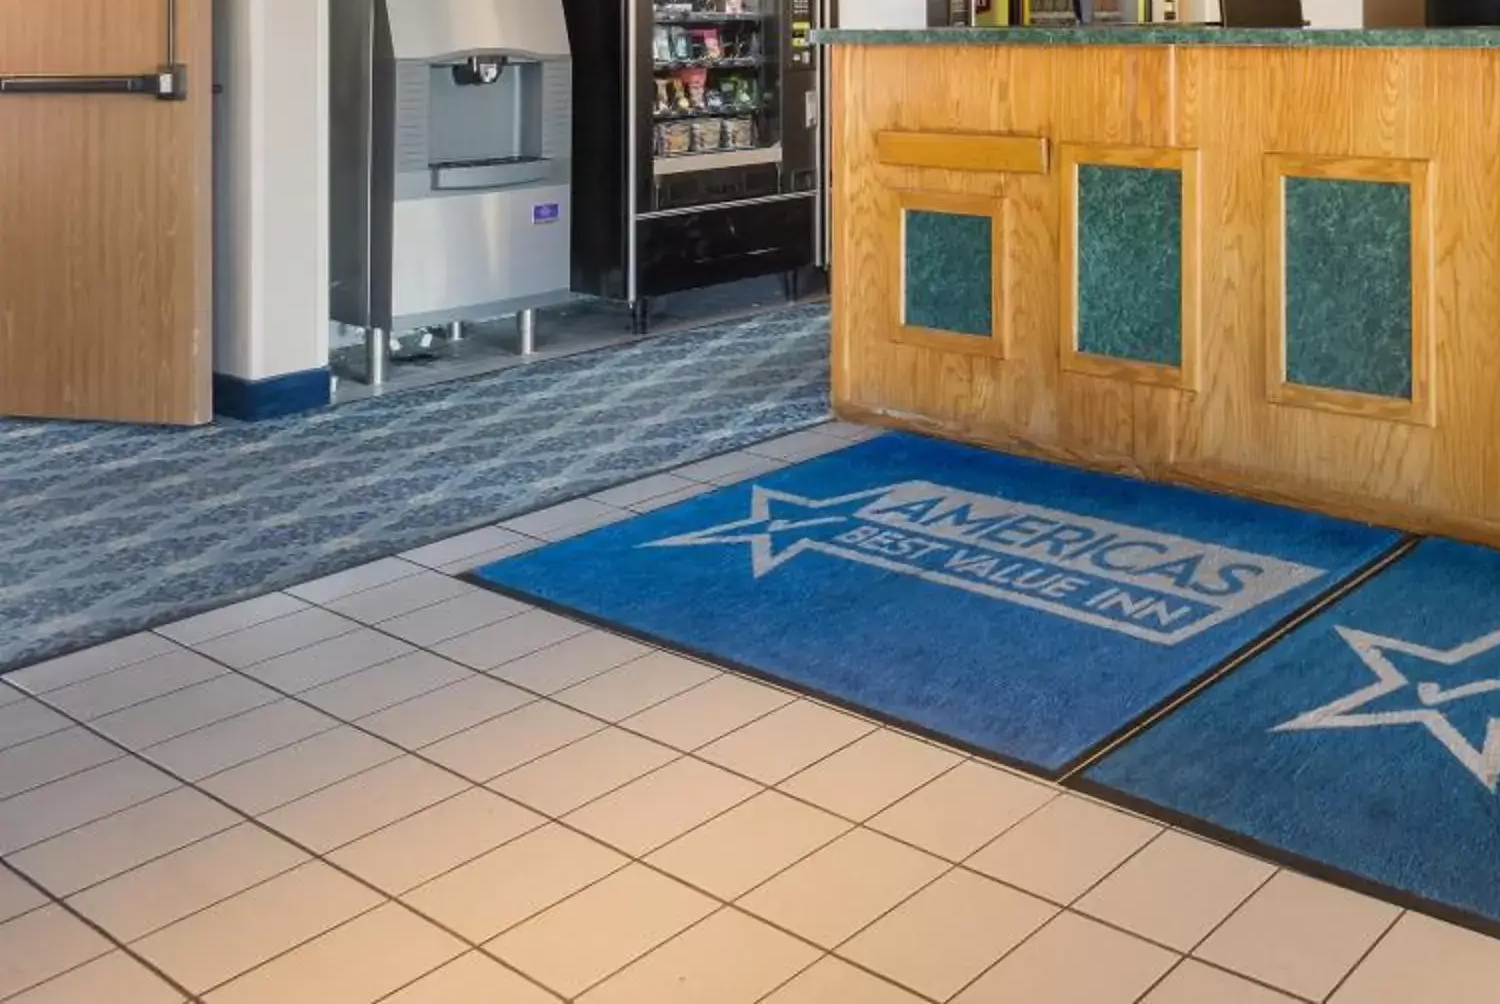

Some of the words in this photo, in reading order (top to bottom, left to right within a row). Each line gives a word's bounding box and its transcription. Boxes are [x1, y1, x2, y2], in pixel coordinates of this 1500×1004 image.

[833, 524, 951, 560] BEST
[943, 548, 1090, 597] VALUE
[1085, 588, 1191, 627] INN
[873, 496, 1262, 596] AMERICAS
